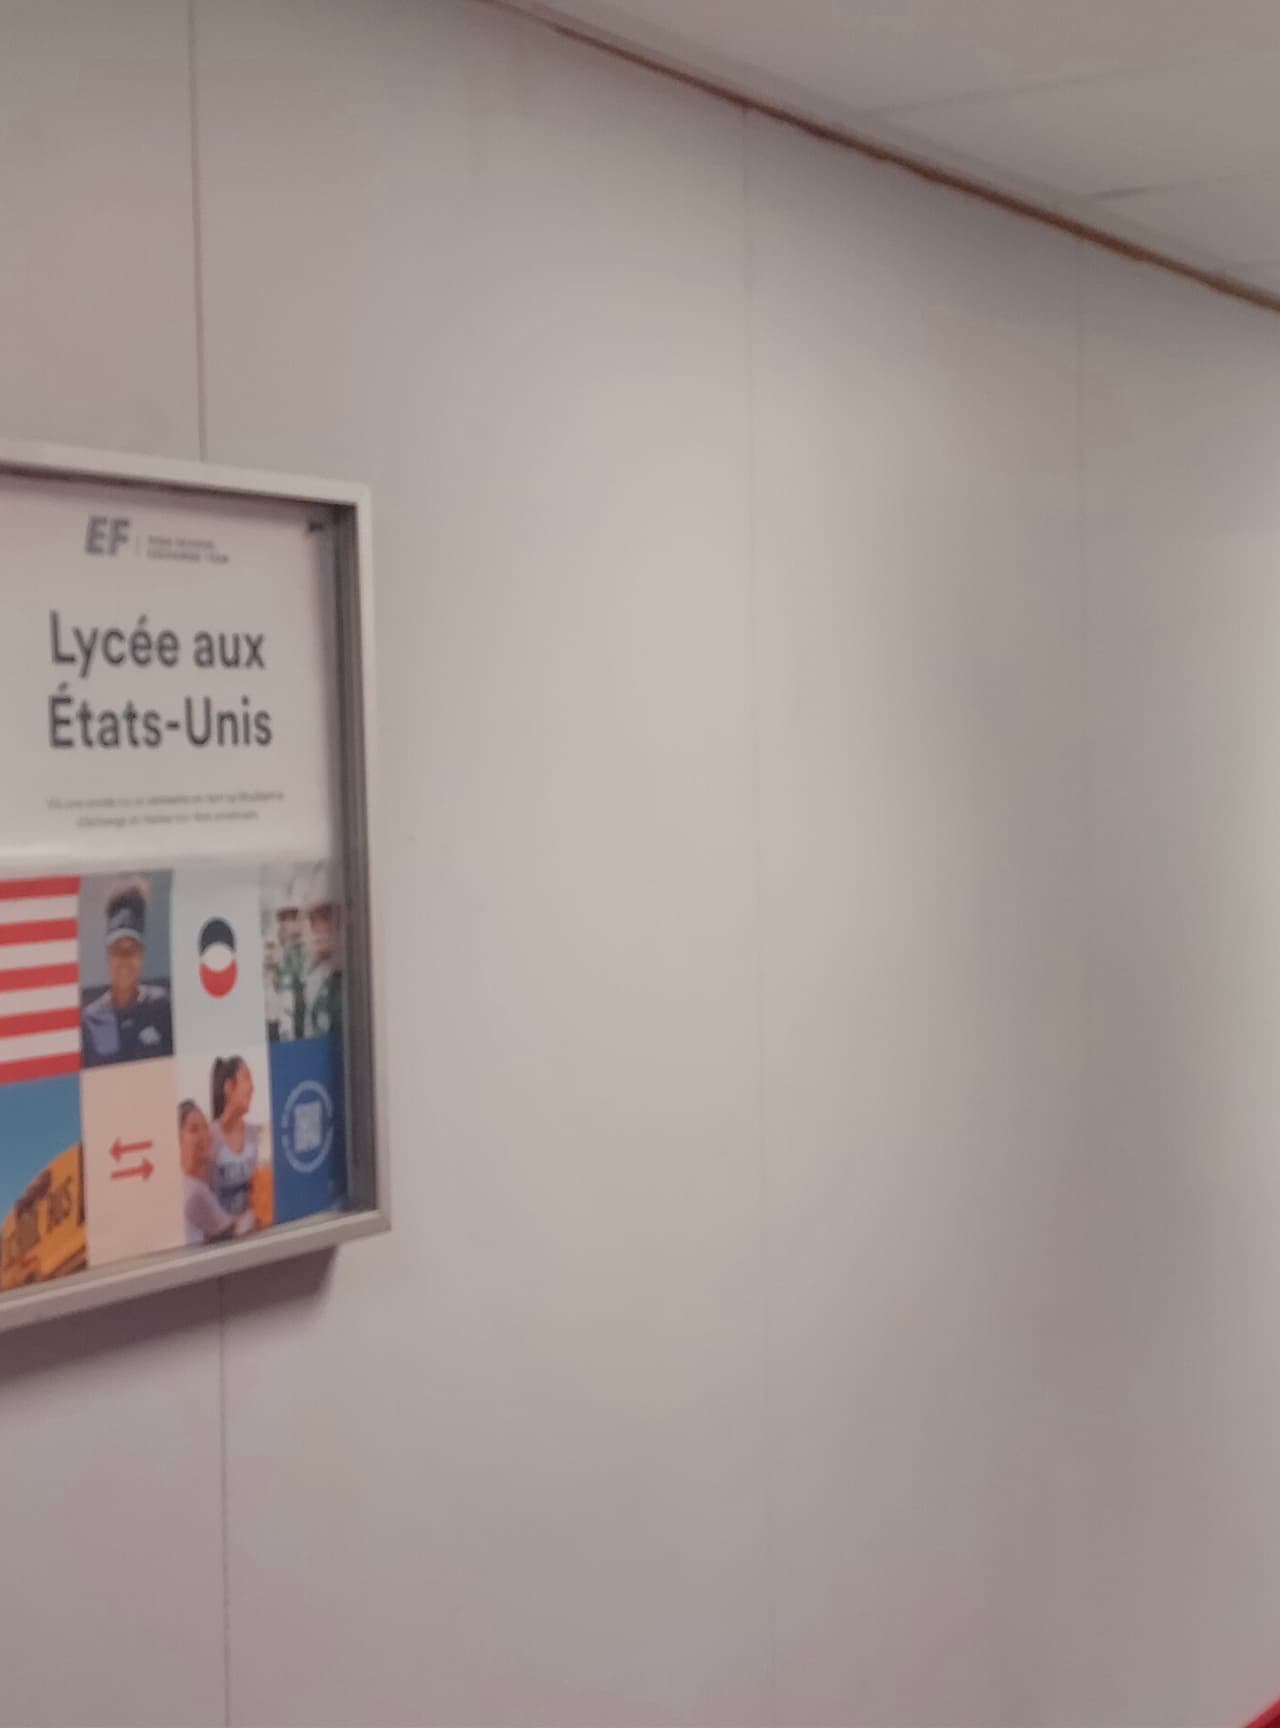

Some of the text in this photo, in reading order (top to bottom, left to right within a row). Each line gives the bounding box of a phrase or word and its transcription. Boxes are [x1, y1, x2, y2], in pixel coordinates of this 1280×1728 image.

[85, 516, 130, 556] EF
[49, 609, 267, 679] Lycée aux
[47, 681, 273, 750] États-Unis
